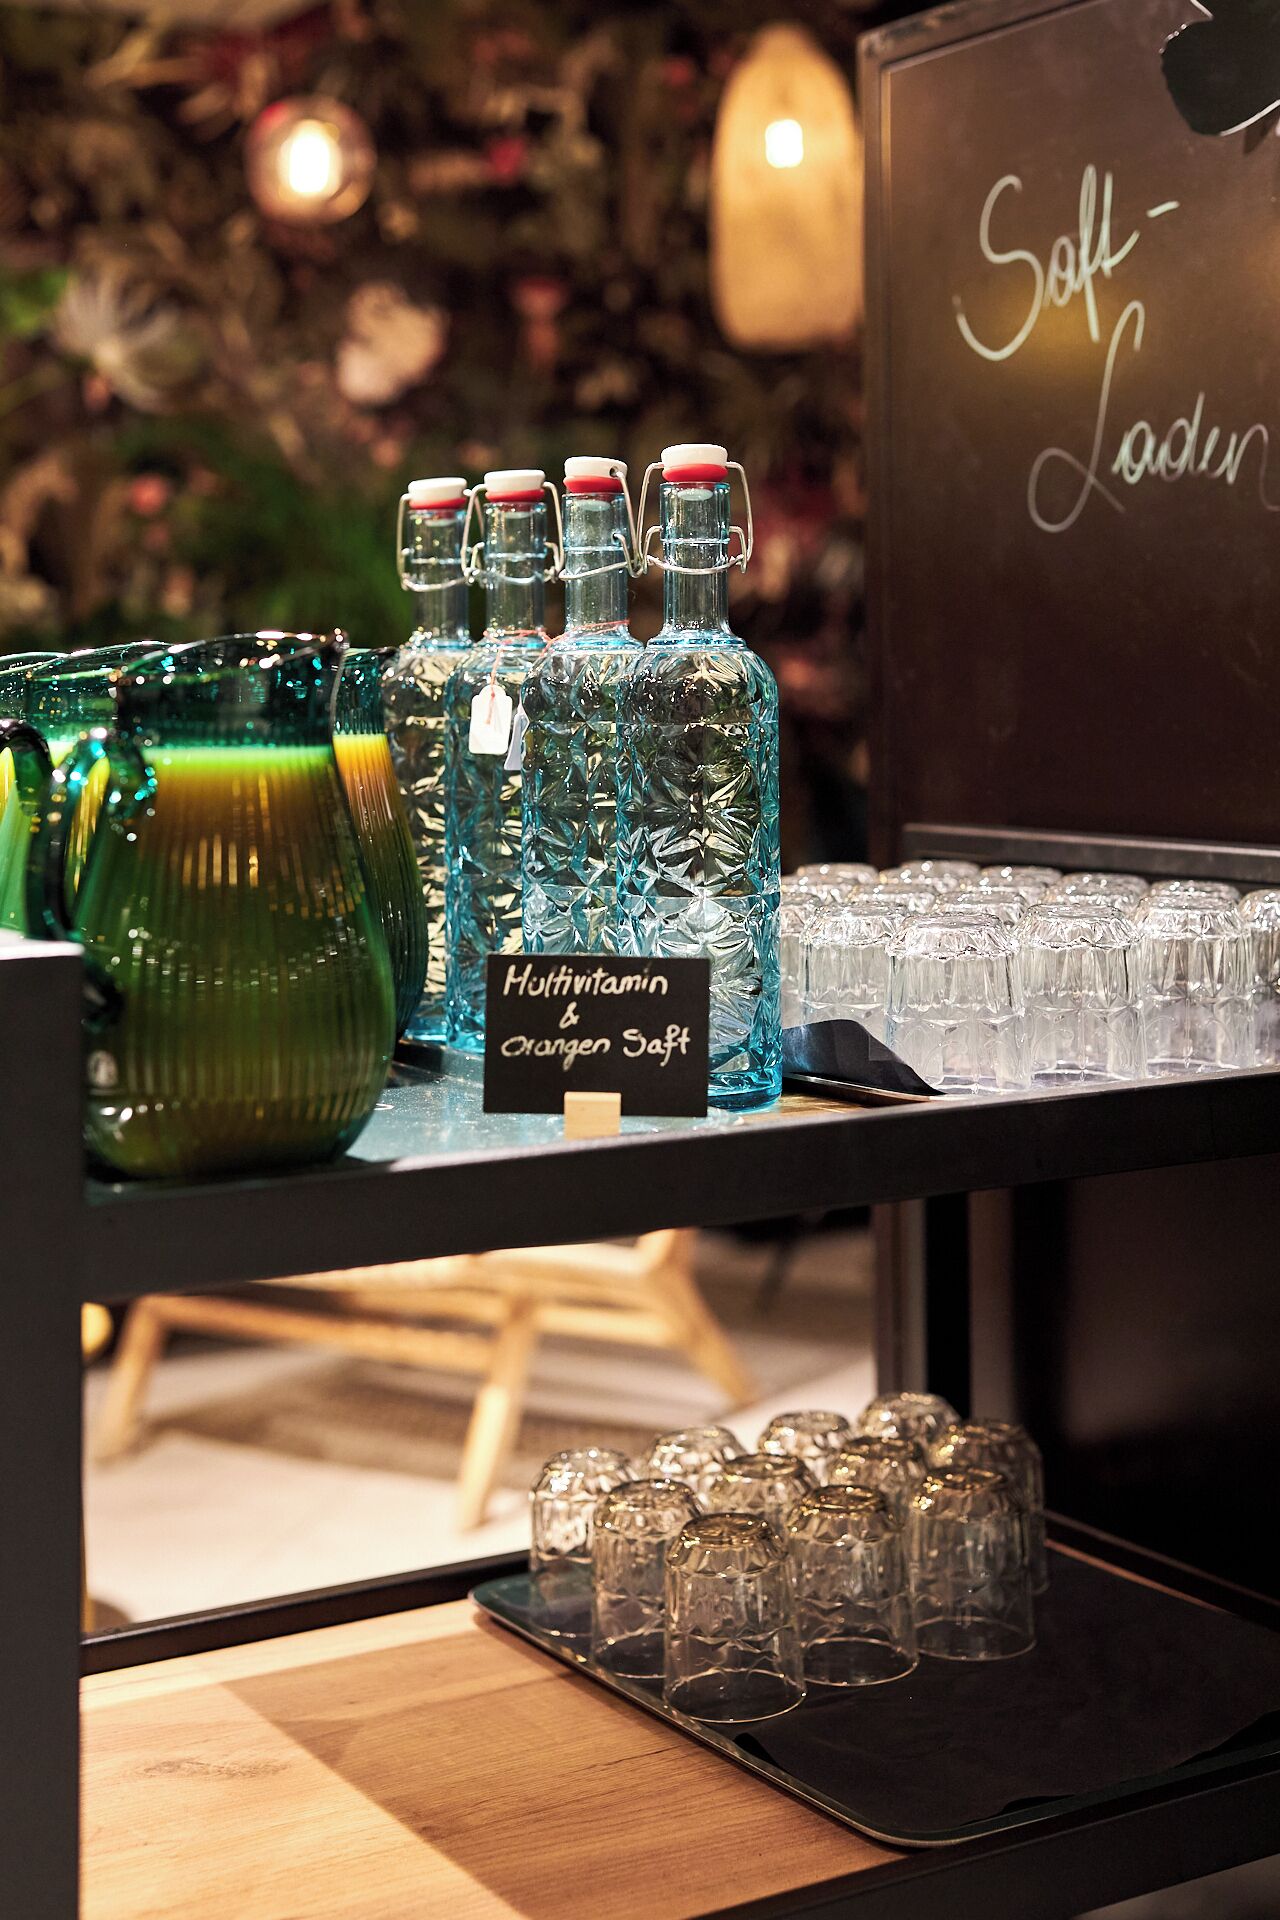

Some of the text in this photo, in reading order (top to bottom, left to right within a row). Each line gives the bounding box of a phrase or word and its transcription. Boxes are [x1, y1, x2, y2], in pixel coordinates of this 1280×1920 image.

[952, 163, 1180, 361] Saft-
[1027, 300, 1280, 533] Laden
[502, 963, 669, 998] Multivitamin
[558, 1001, 581, 1030] &
[500, 1023, 691, 1071] Orangen Saft
